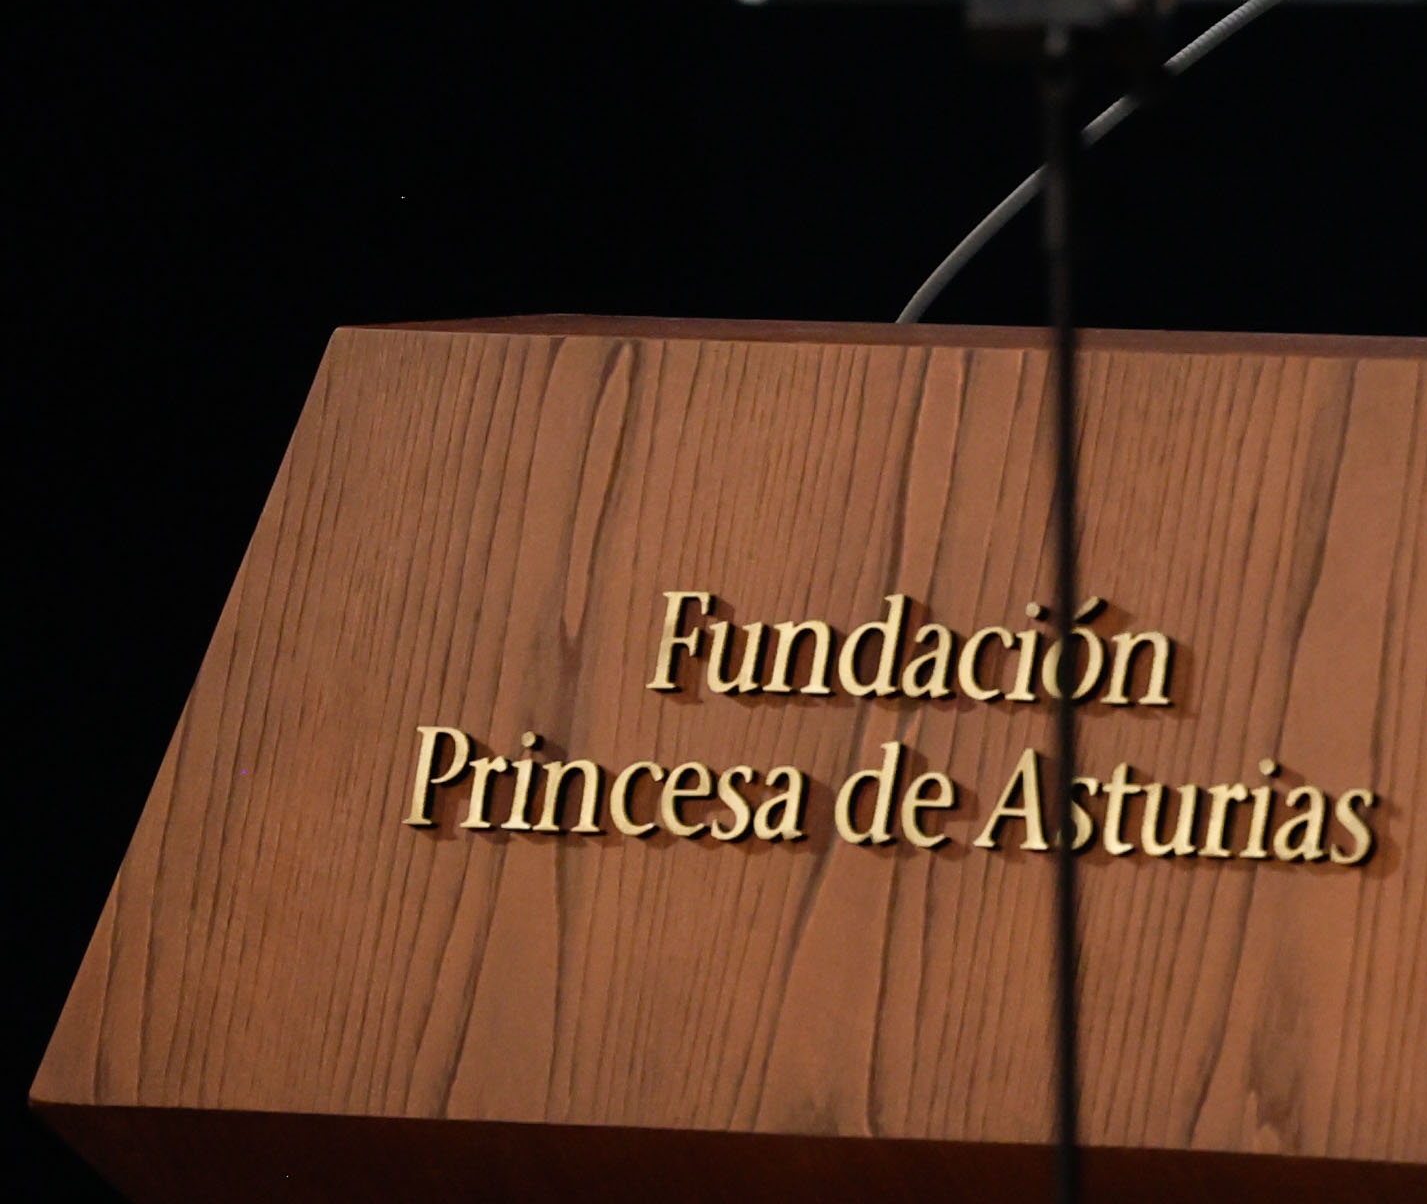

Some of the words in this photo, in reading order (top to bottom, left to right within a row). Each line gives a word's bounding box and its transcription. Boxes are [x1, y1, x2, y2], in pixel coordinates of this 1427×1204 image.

[645, 590, 1174, 707] Fundación
[403, 725, 806, 843] Princesa
[834, 741, 956, 848] de
[973, 747, 1378, 867] Asturias
